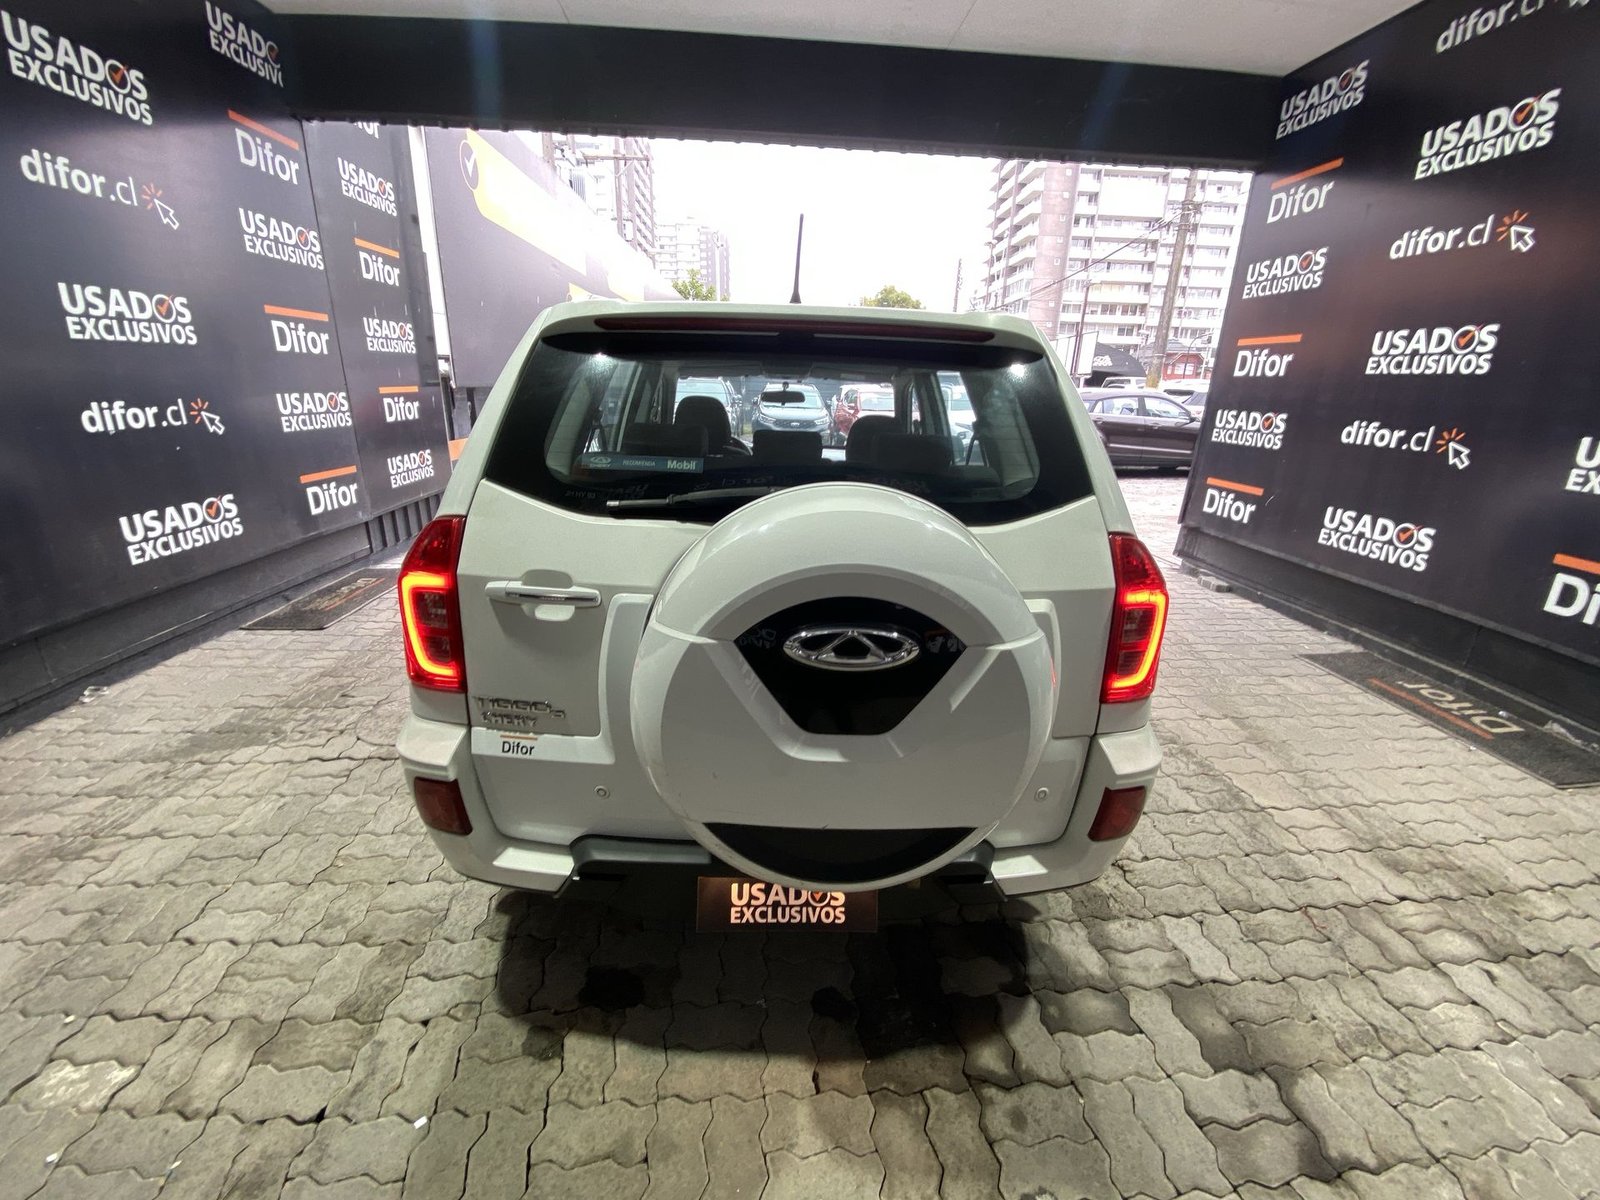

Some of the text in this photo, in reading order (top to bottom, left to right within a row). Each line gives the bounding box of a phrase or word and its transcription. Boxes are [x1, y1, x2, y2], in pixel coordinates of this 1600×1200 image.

[206, 0, 281, 69] USADO
[1, 10, 148, 101] USADOS
[209, 28, 284, 88] EXCLUSIV
[7, 50, 153, 126] EXCLUSIVOS
[1280, 59, 1370, 121] USADOS
[1275, 86, 1365, 140] EXCLUSIVOS
[1421, 88, 1562, 157] USADOS
[235, 127, 299, 185] Difor
[1414, 121, 1555, 180] EXCLUSIVOS
[20, 149, 138, 207] difor.cl
[337, 157, 395, 202] USADOS
[341, 179, 398, 217] EXCLUSIVOS
[1266, 181, 1334, 224] Difor
[239, 208, 320, 253] USADOS
[1389, 214, 1495, 260] difor.cl
[244, 234, 324, 271] EXCLUSIVOS
[360, 251, 400, 287] Difor
[1247, 247, 1329, 284] USADOS
[1242, 270, 1324, 299] EXCLUSIVOS
[58, 283, 192, 323] USADOS
[65, 316, 197, 345] EXCLUSIVOS
[271, 320, 329, 355] Difor
[363, 316, 413, 341] USADOS
[367, 337, 416, 354] EXCLUSIVOS
[1372, 323, 1500, 356] USADOS
[1233, 348, 1293, 377] Difor
[1365, 352, 1492, 375] EXCLUSIVOS
[81, 399, 188, 433] difor.cl
[276, 392, 349, 415] USADOS
[281, 411, 352, 432] EXCLUSIVOS
[384, 398, 420, 423] Difor
[1215, 409, 1288, 433] USADOS
[1211, 427, 1284, 450] EXCLUSIVOS
[1341, 420, 1436, 452] difor.cl
[387, 449, 432, 475] USADOS
[390, 465, 434, 489] EXCLUSIVOS
[306, 482, 358, 516] Difor
[1202, 489, 1256, 524] Difor
[119, 493, 239, 543] USADOS
[1324, 507, 1436, 553] USADOS
[127, 517, 244, 566] EXCLUSIVOS
[1318, 529, 1429, 572] EXCLUSIVOS
[502, 741, 535, 756] Difor
[731, 883, 846, 906] USADOS
[731, 907, 846, 924] EXCLUSIVOS
